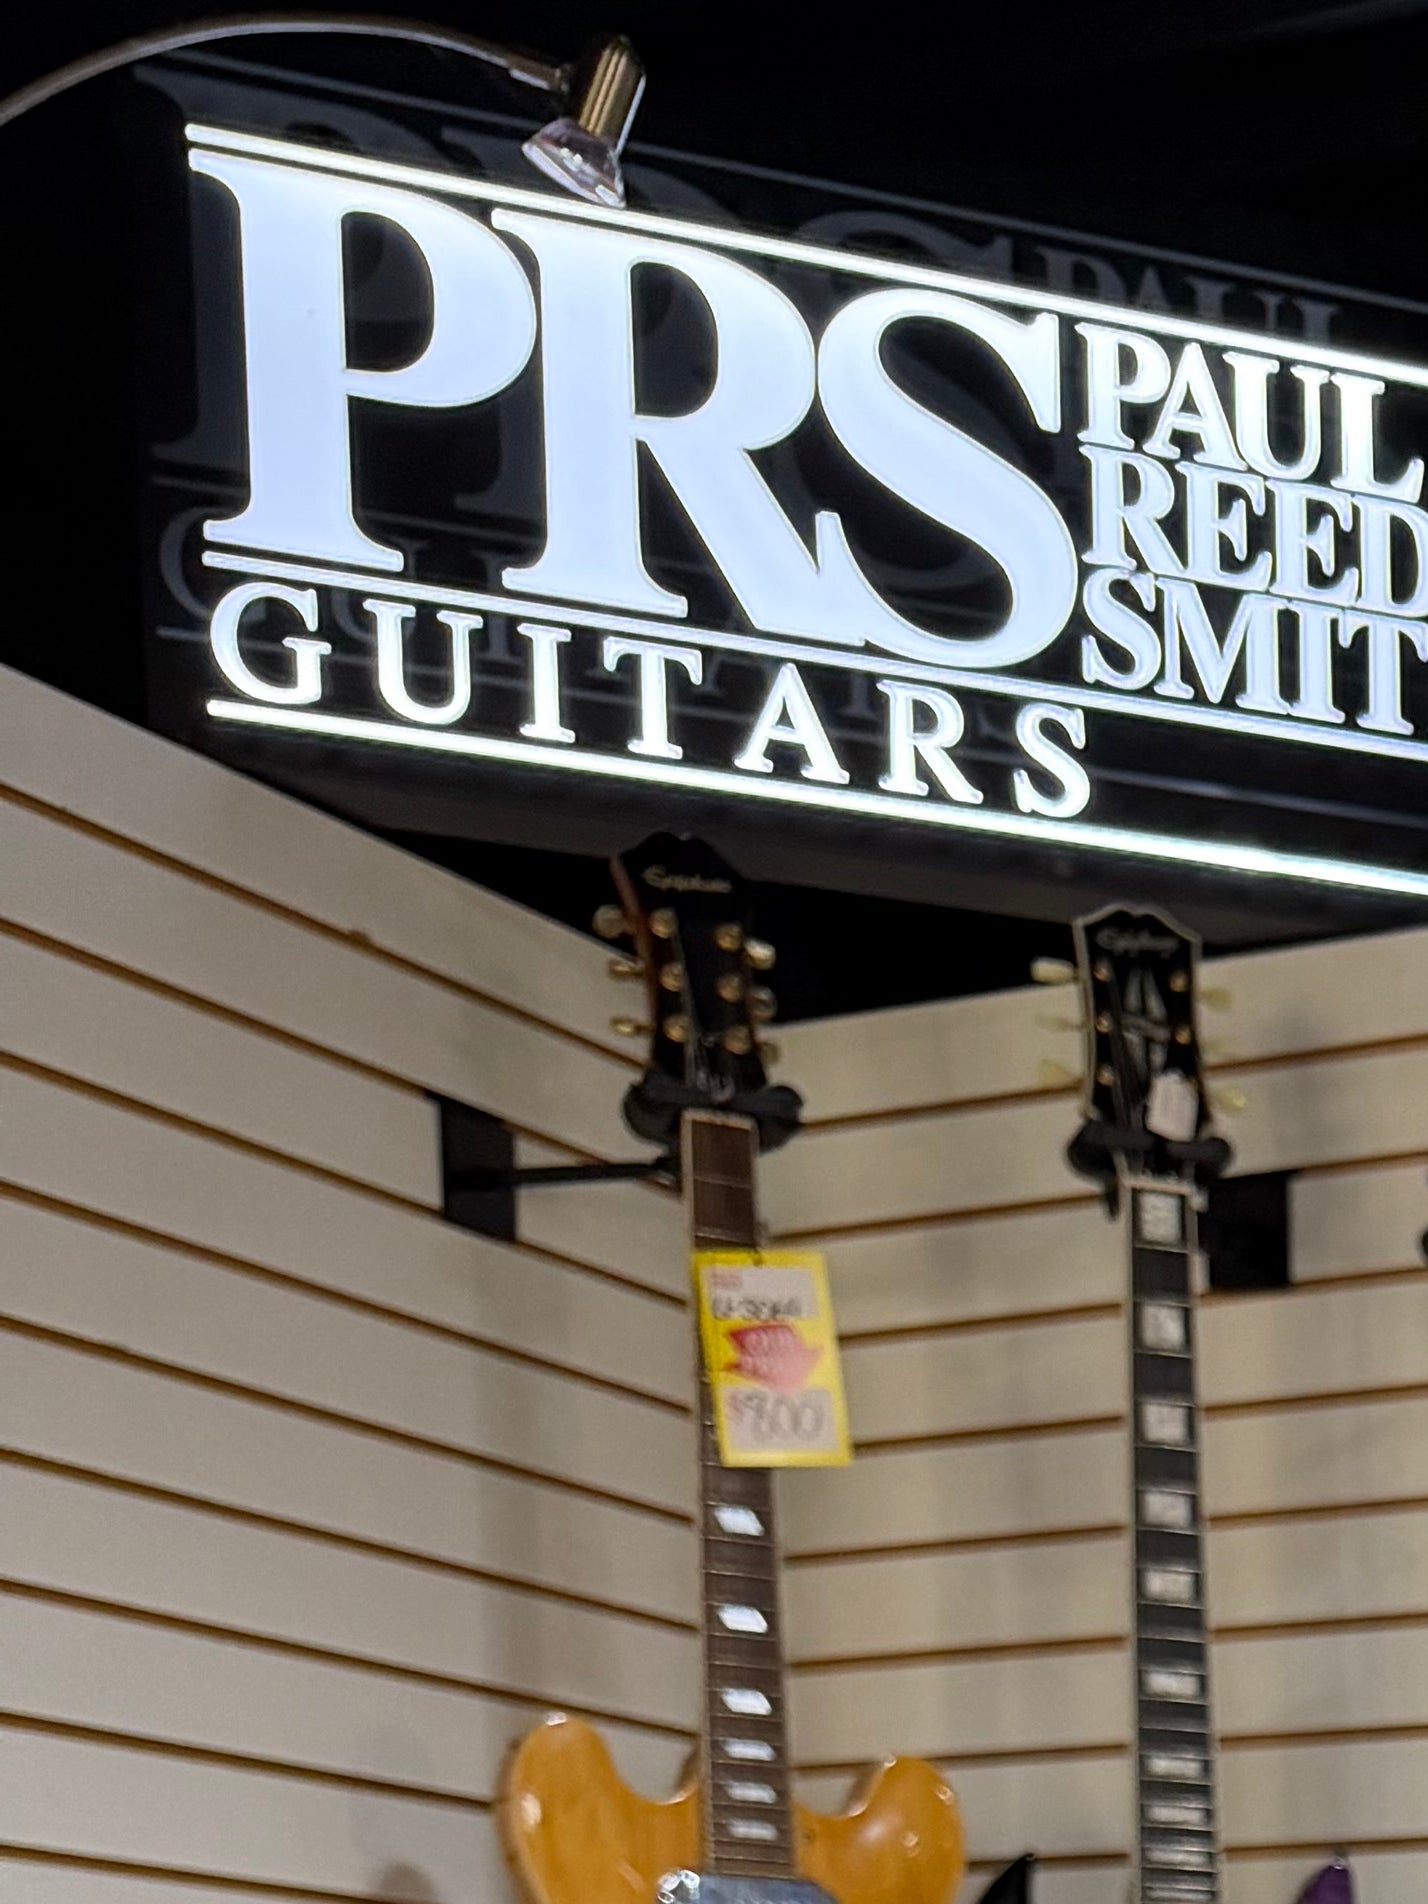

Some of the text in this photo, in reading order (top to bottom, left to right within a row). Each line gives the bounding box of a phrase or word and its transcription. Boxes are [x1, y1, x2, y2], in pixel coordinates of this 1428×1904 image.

[187, 147, 1079, 669] PRS
[1075, 322, 1425, 503] PAUL
[209, 581, 1093, 819] GUITARS
